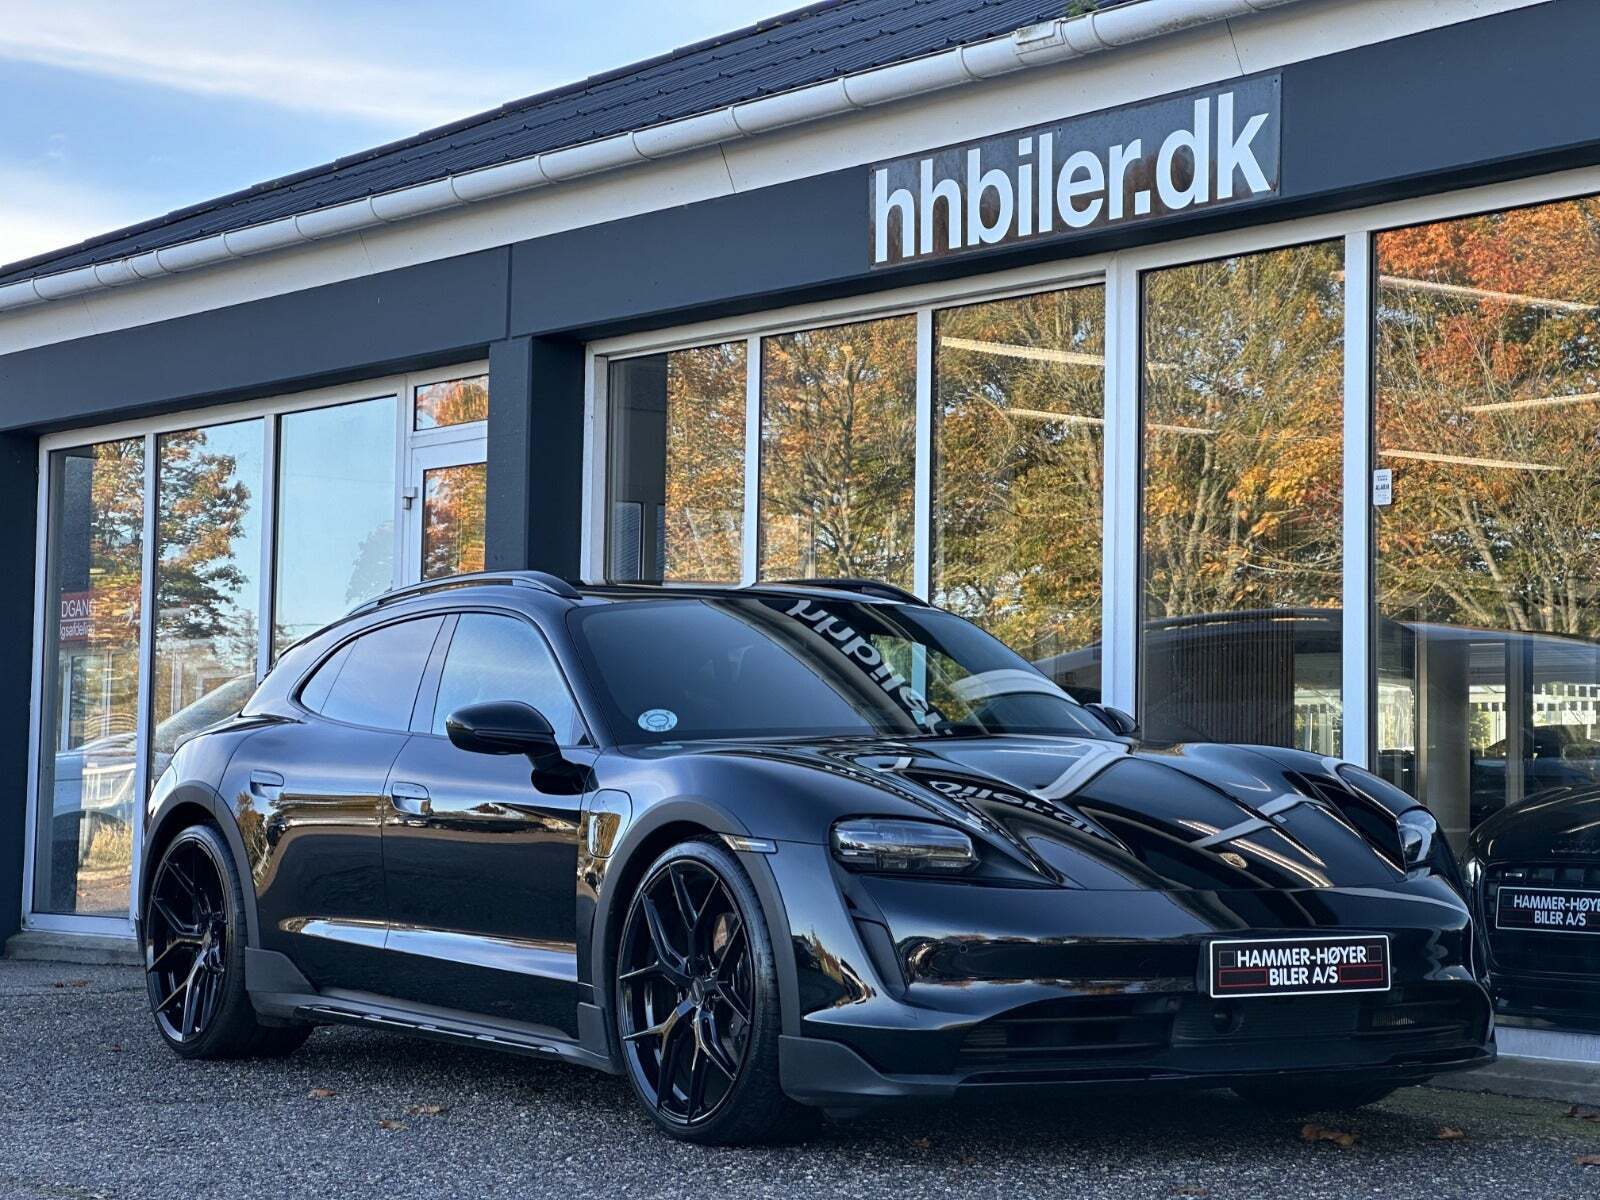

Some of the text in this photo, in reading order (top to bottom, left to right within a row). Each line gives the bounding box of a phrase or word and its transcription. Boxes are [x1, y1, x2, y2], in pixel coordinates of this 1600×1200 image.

[875, 91, 1271, 263] hhbiler.dk
[1534, 910, 1586, 926] BILER A/S
[1237, 945, 1367, 968] HAMMER-HØYER
[1269, 966, 1339, 986] BILER A/S
